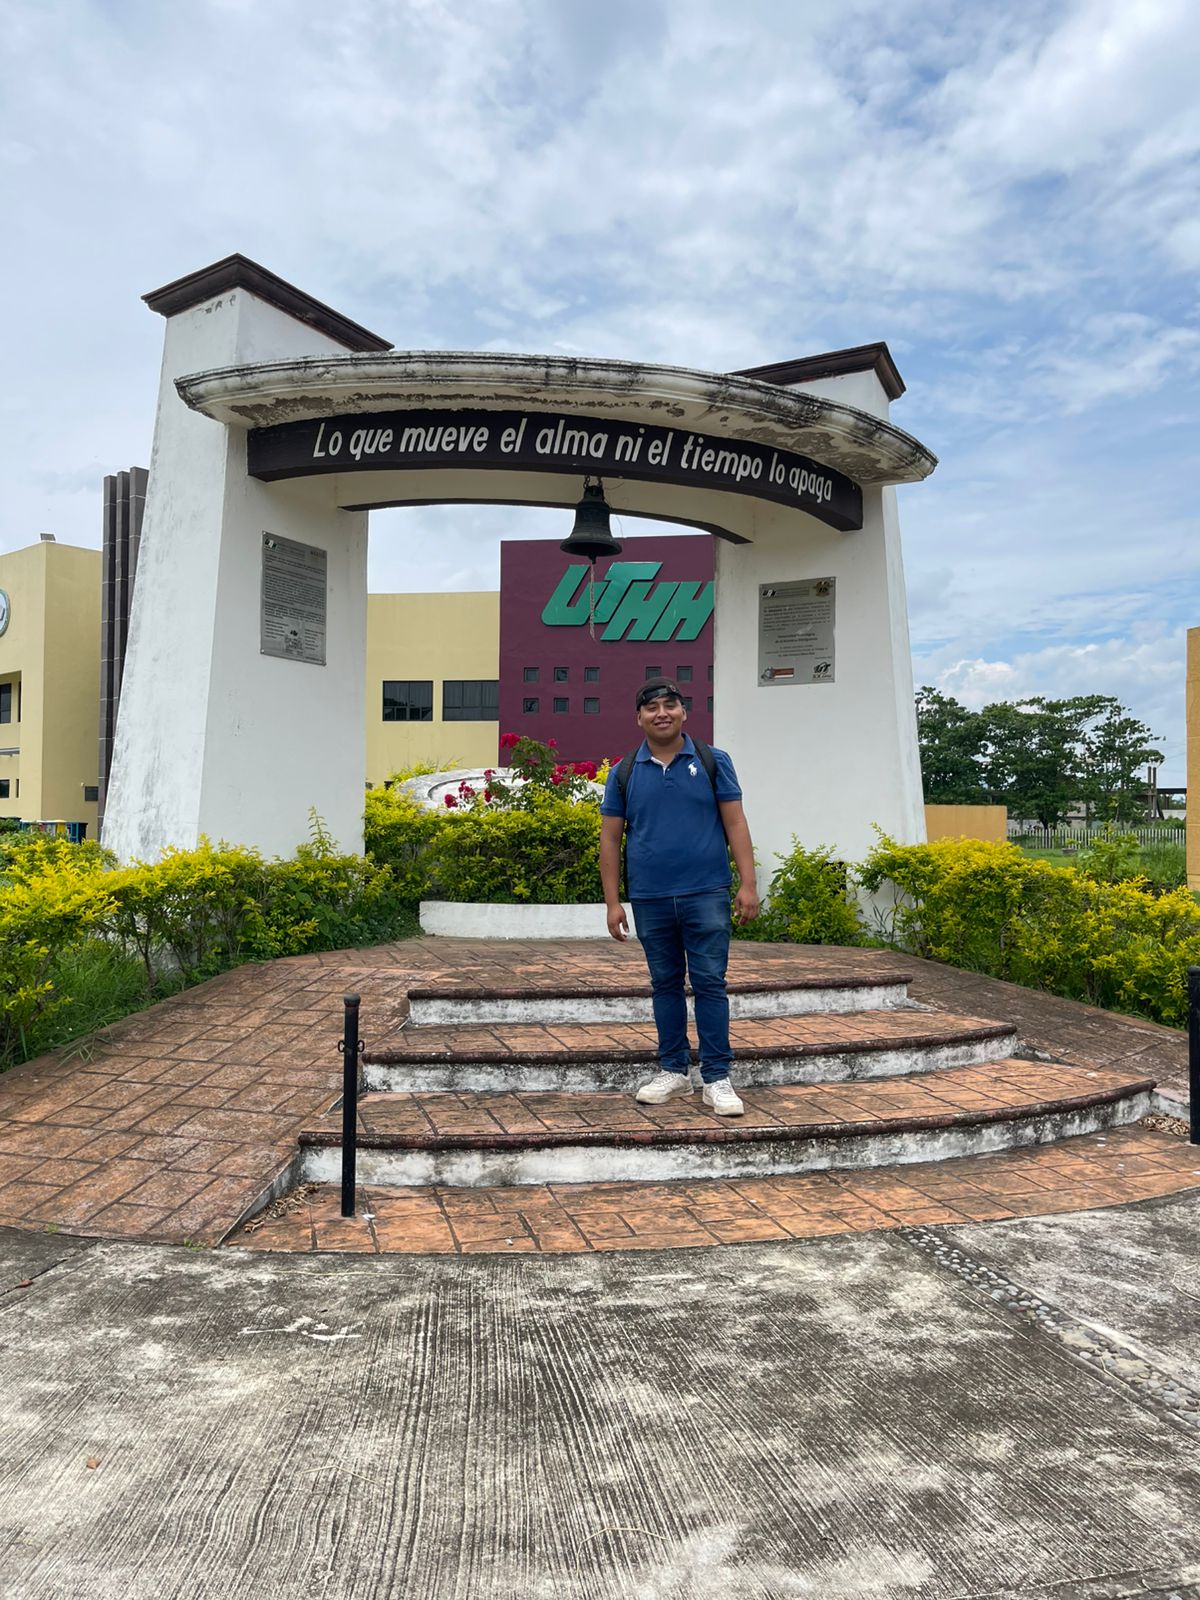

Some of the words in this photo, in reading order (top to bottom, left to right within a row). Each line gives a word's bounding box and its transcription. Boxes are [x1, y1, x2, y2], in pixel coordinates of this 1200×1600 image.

[313, 422, 343, 458] Lo
[350, 428, 394, 461] que
[400, 425, 489, 453] mueve
[500, 417, 528, 454] el
[535, 418, 608, 458] alma
[615, 428, 645, 463] ni
[648, 432, 674, 466] el
[680, 435, 762, 482] tiempo
[768, 452, 786, 485] lo
[789, 467, 833, 504] apaga
[540, 561, 715, 642] UTHH
